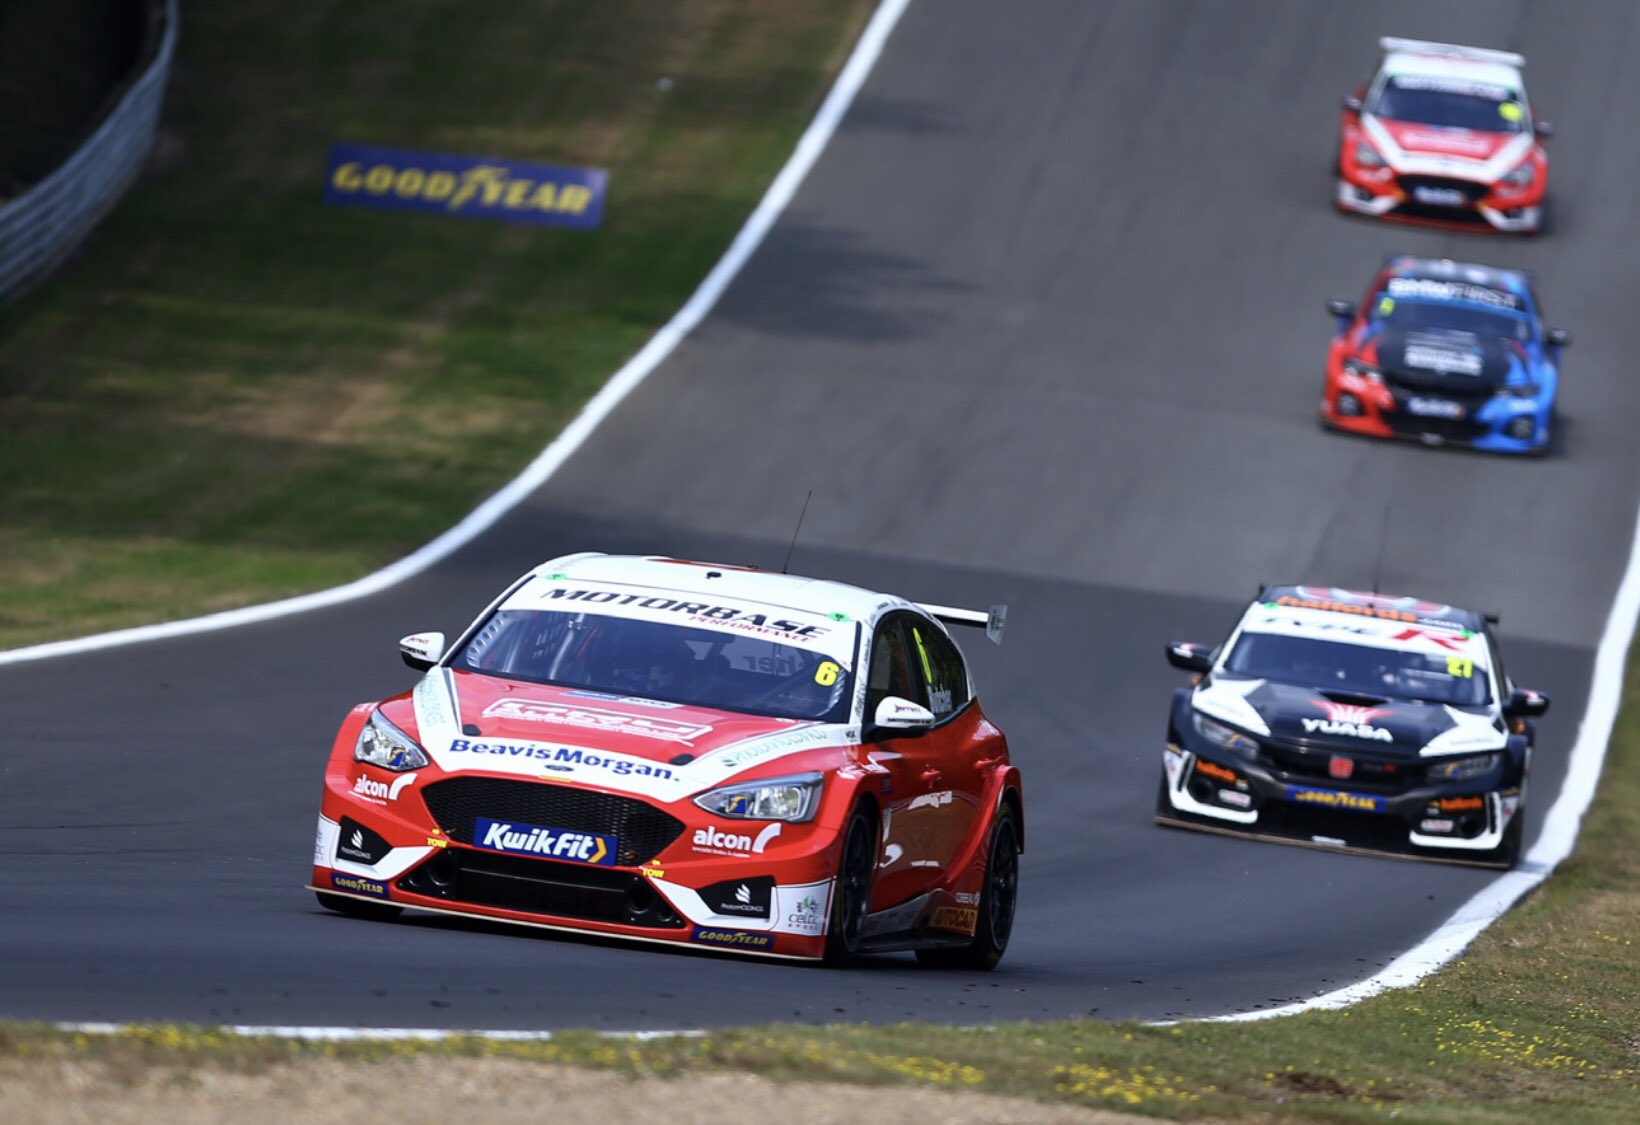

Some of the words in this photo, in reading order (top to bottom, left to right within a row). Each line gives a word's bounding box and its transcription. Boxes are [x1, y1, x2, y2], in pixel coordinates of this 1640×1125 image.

[332, 162, 592, 214] GOODYEAR
[541, 588, 831, 638] MOTORBASE
[689, 615, 812, 642] PERFORMANCE
[814, 661, 841, 686] 6
[1301, 717, 1394, 744] YUASA
[354, 773, 389, 799] alcon
[1295, 791, 1376, 811] GOODYEAR
[426, 837, 448, 849] TOW
[693, 825, 752, 851] alcon
[335, 877, 384, 894] GOODYEAR
[642, 867, 665, 879] TOW
[698, 931, 768, 946] GOODYEAR
